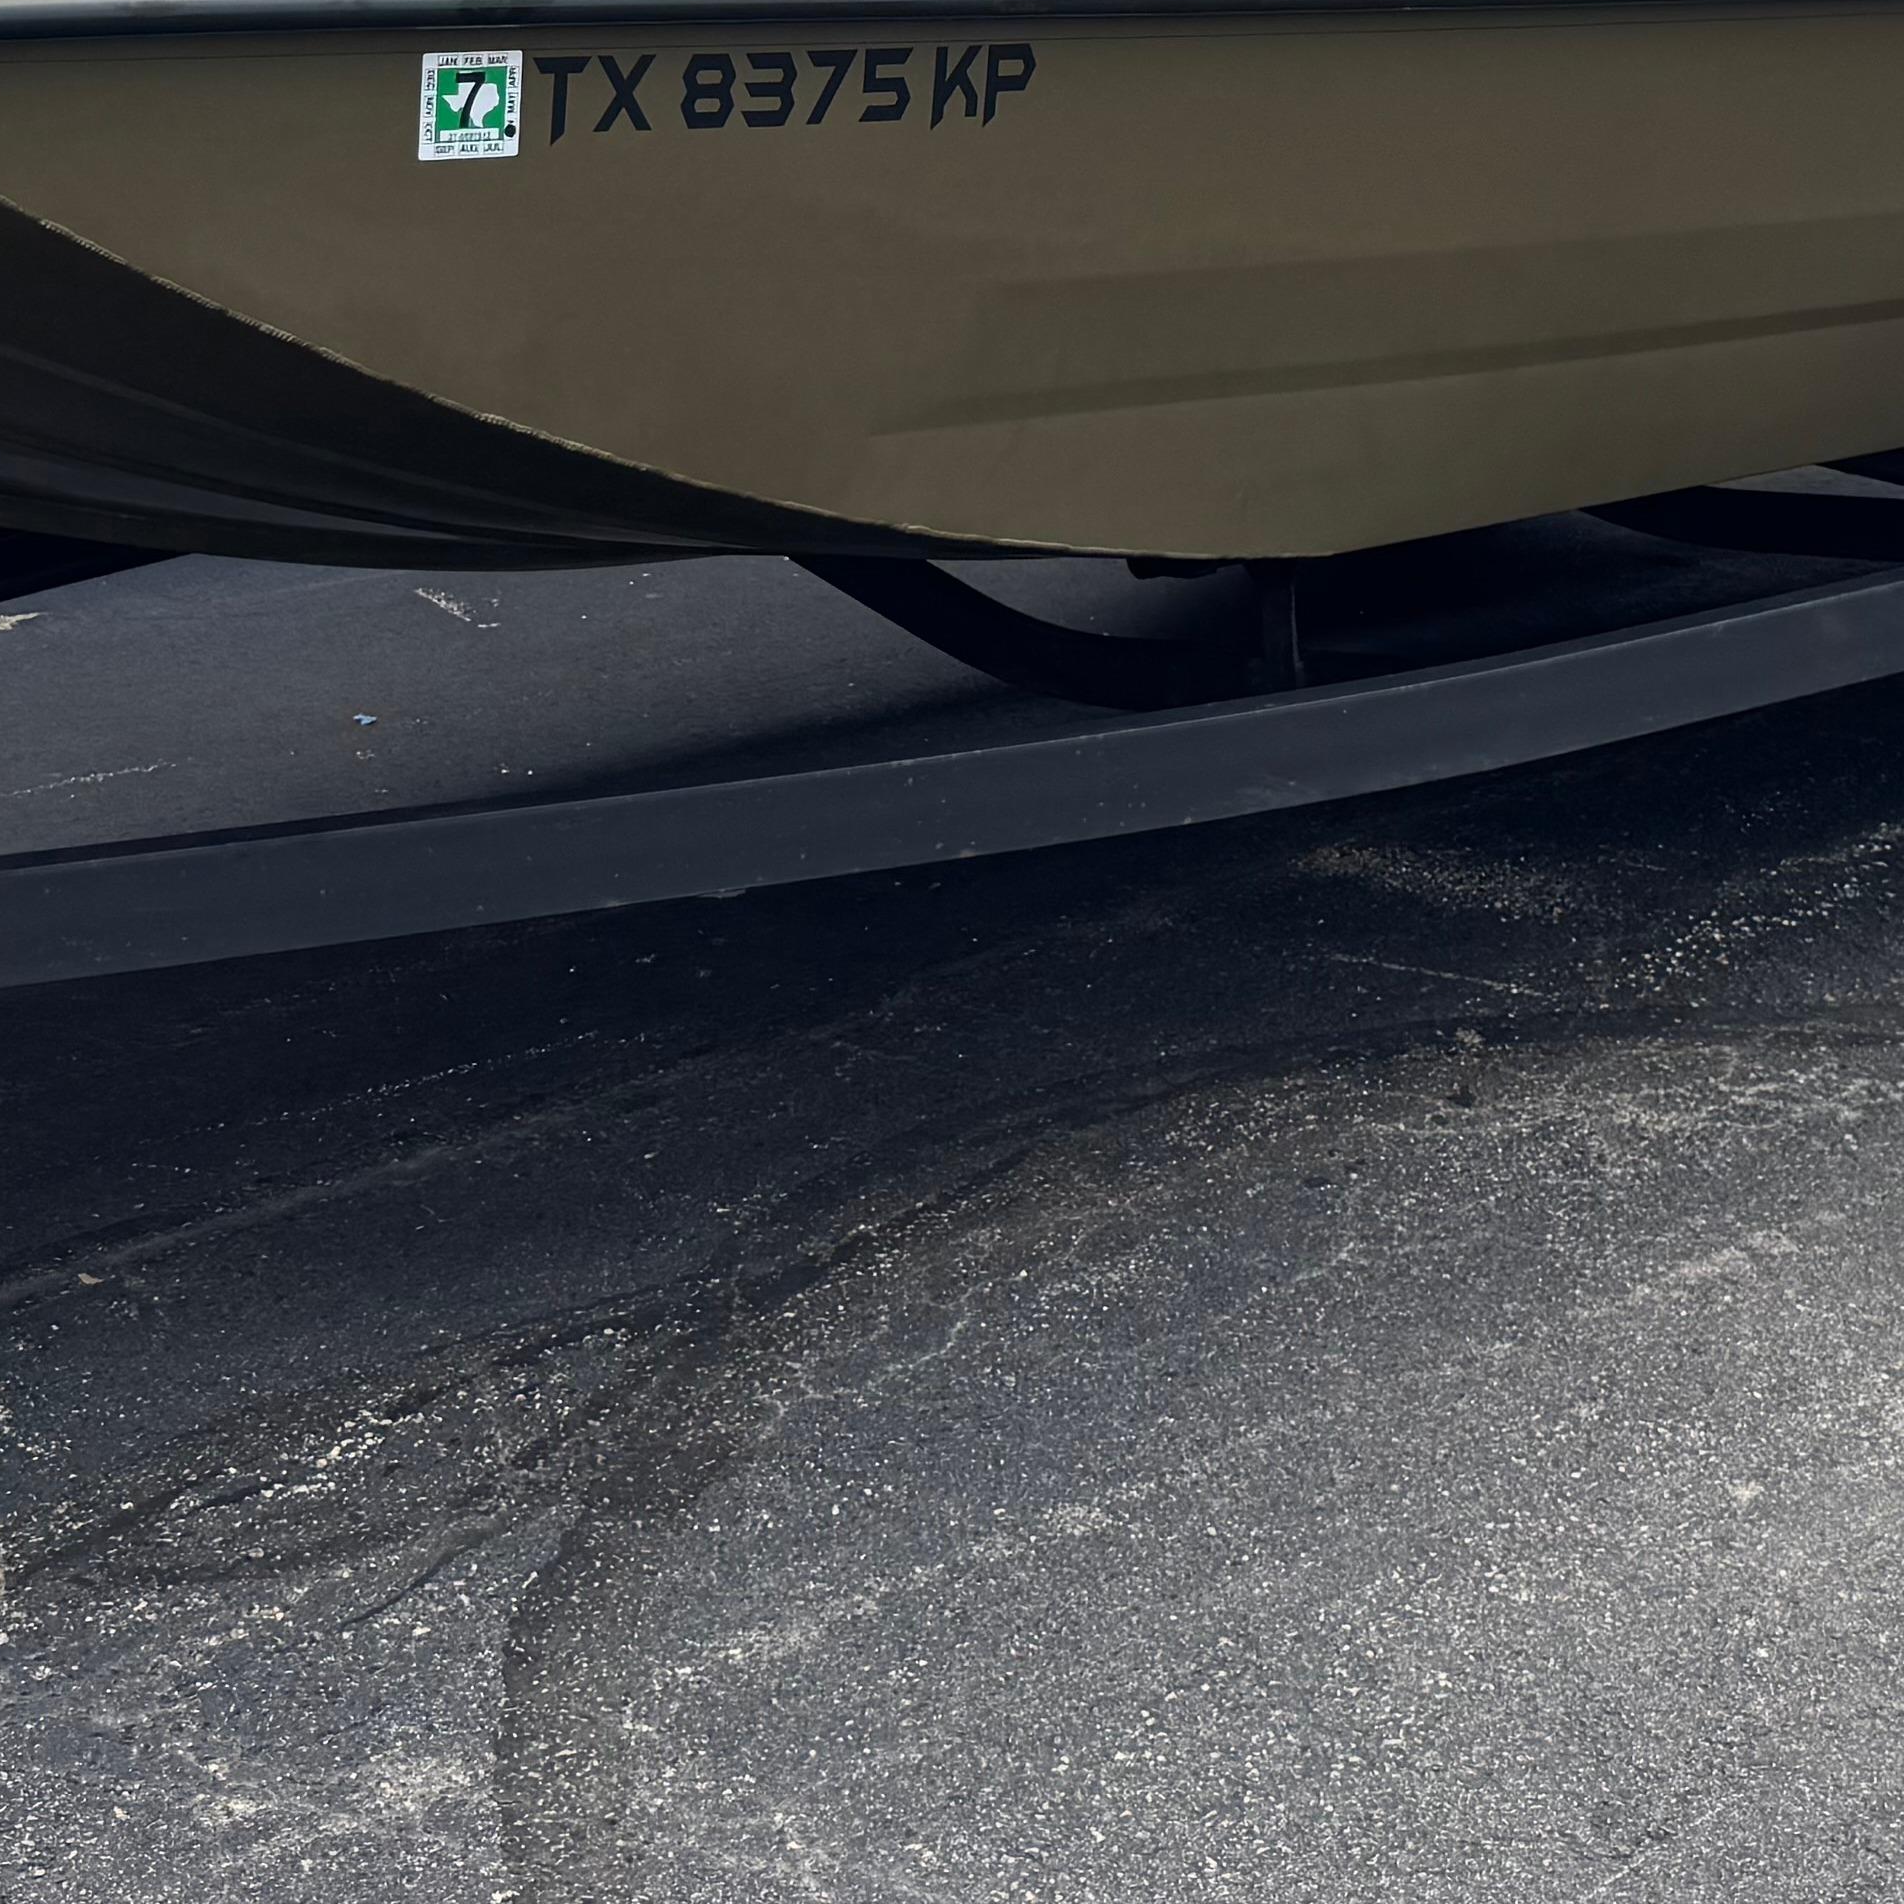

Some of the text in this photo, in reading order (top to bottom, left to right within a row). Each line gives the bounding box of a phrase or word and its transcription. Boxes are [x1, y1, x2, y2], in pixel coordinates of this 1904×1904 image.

[456, 71, 486, 129] 7
[533, 43, 1037, 146] TX 8375 KP
